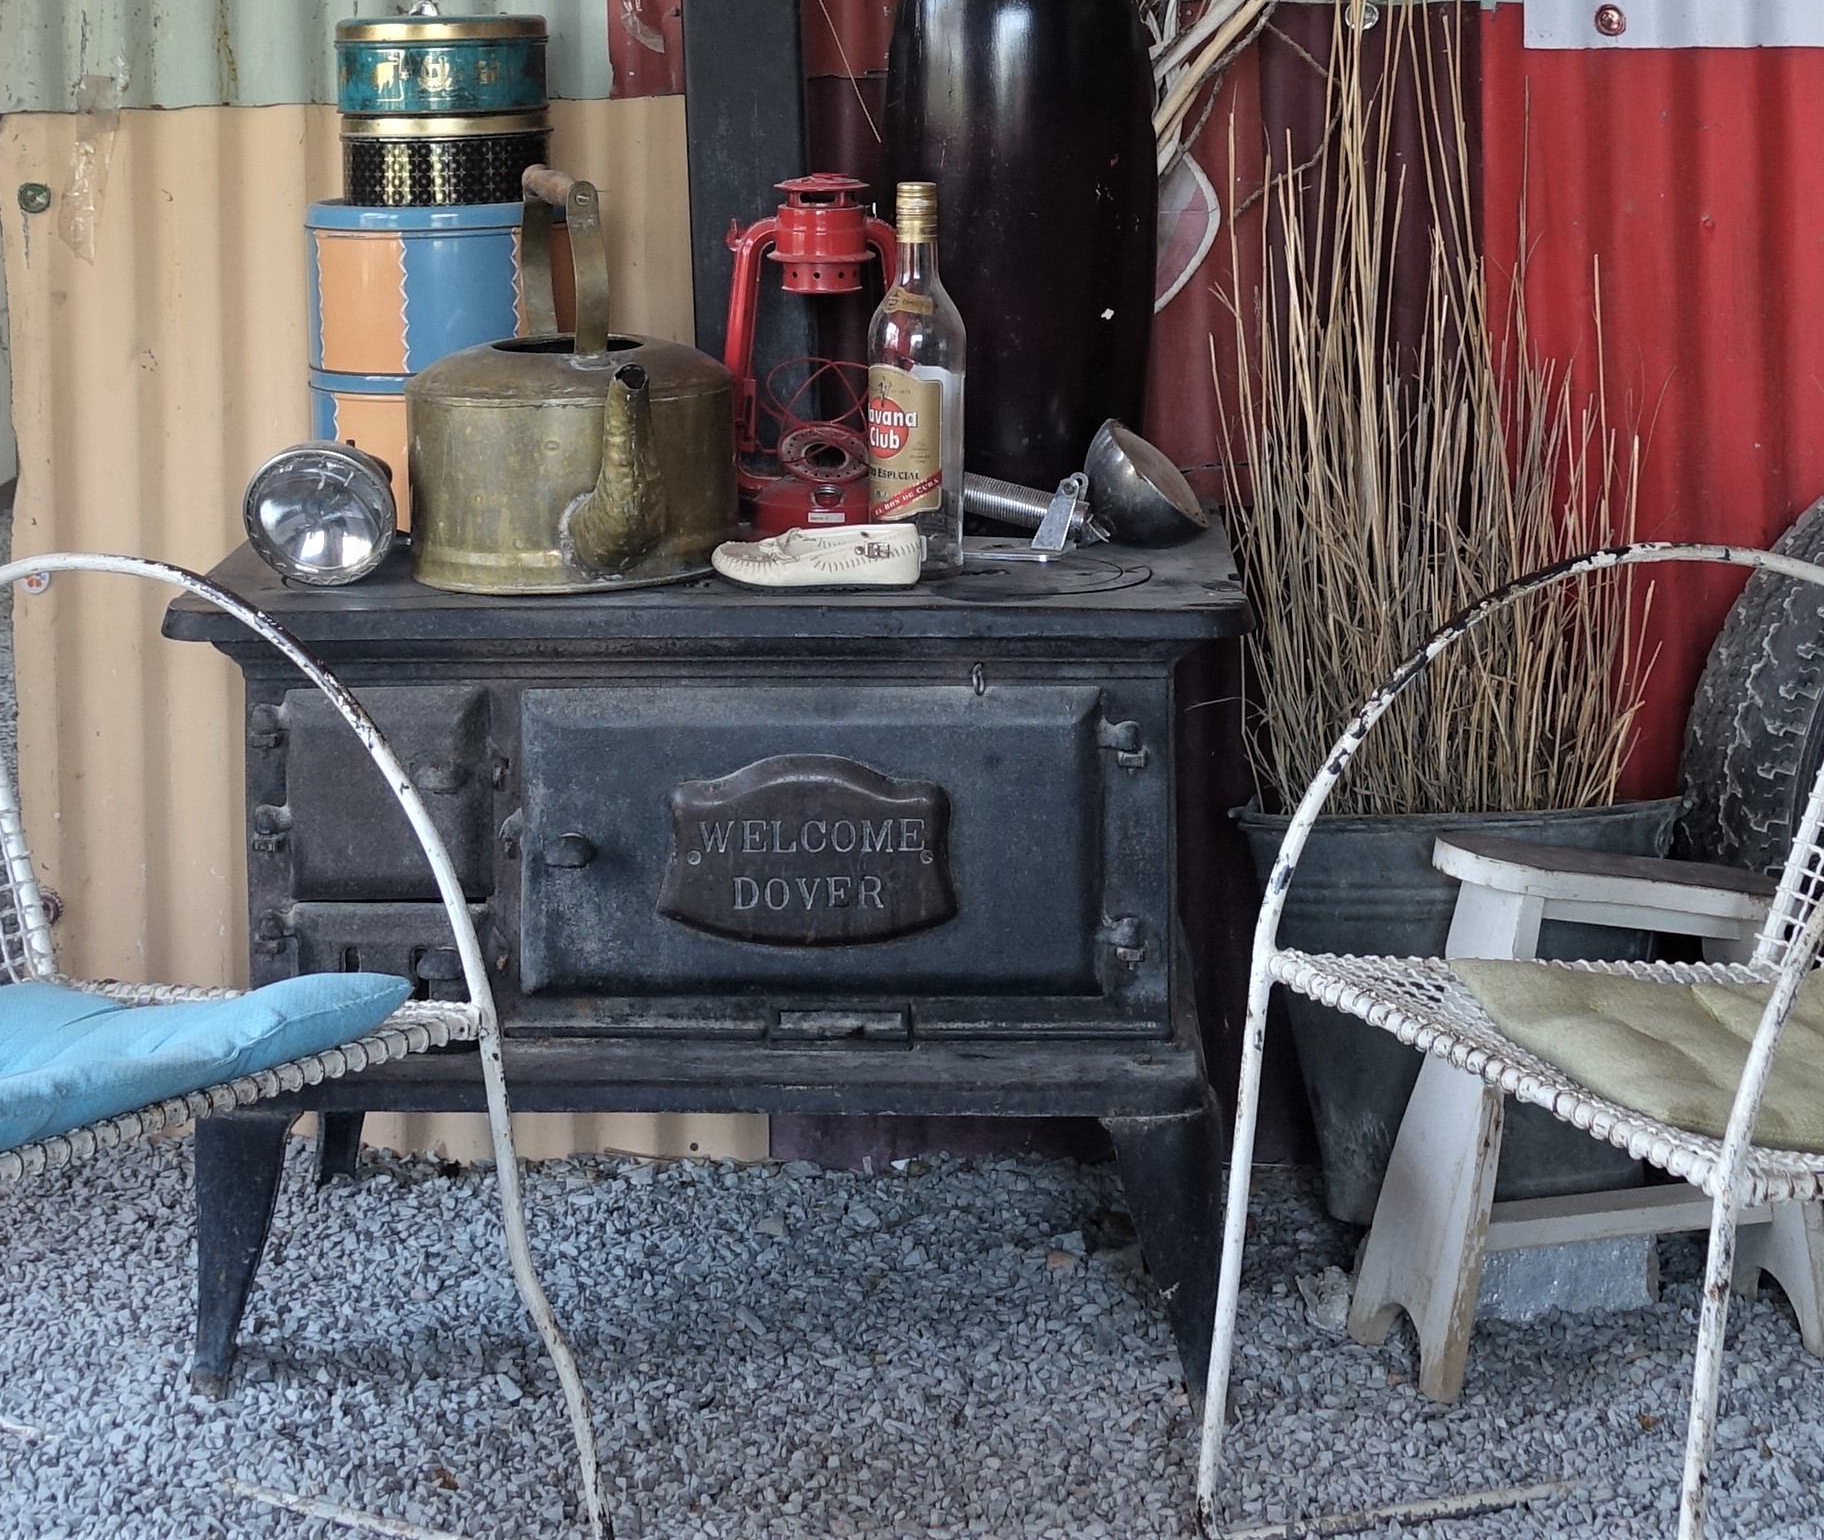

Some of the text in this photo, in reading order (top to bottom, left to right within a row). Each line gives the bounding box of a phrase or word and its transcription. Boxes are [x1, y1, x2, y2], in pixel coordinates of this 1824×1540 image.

[868, 408, 918, 428] avana
[869, 426, 900, 450] Club
[698, 818, 925, 853] WELCOME
[733, 876, 885, 911] DOVER
